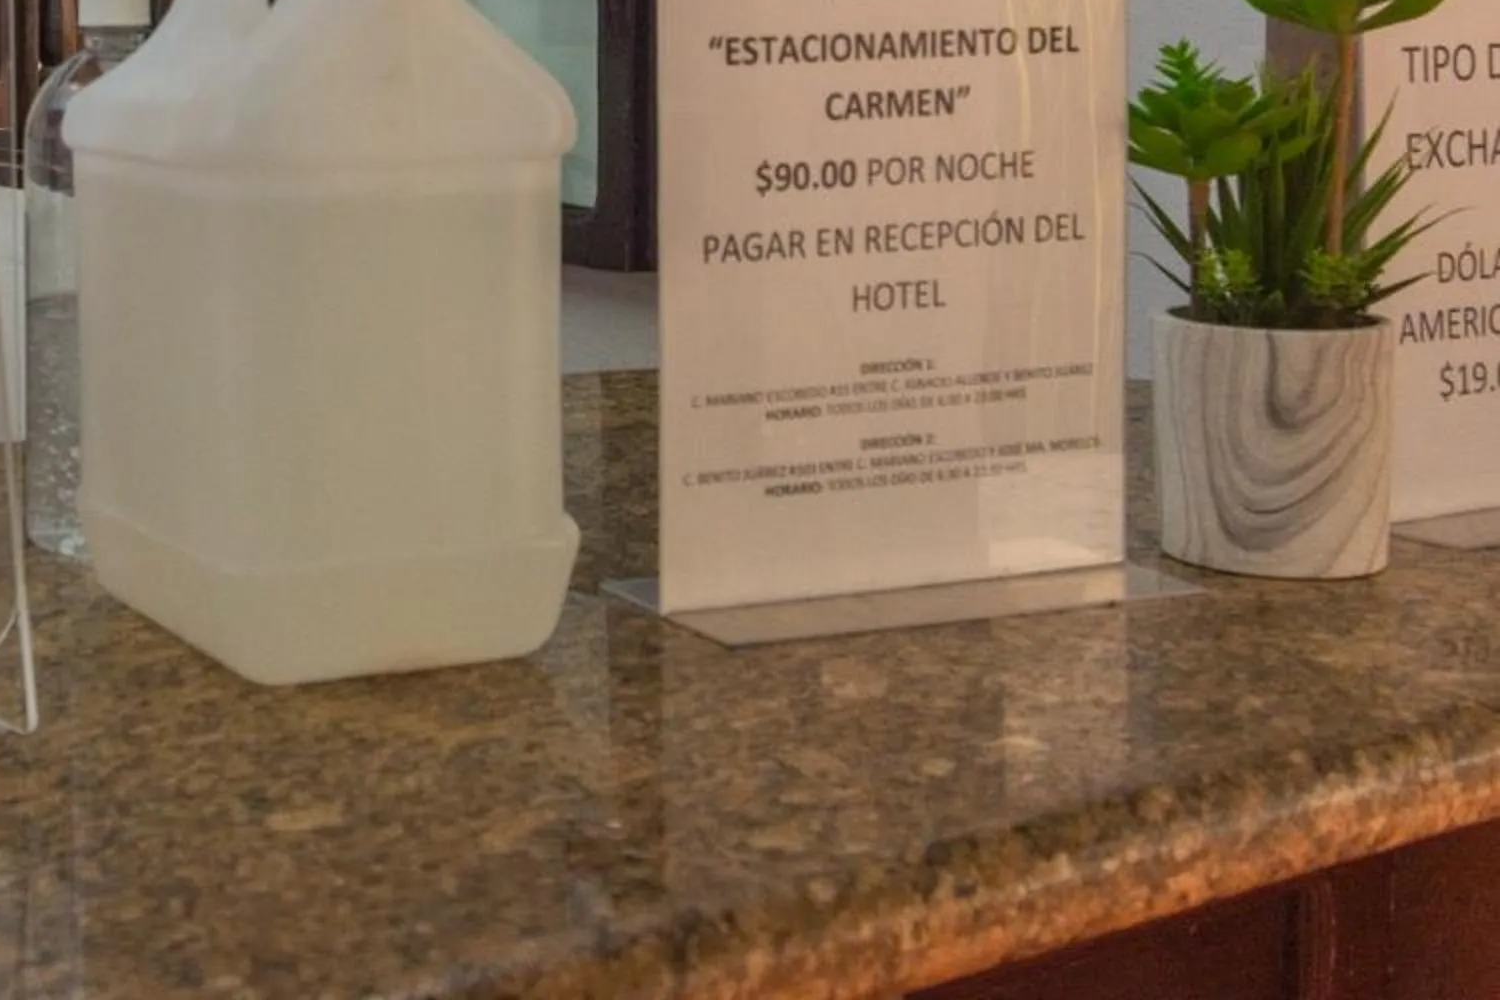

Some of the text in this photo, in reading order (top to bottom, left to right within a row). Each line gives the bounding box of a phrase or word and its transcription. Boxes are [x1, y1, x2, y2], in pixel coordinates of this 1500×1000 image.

[1027, 25, 1080, 55] DEL
[1400, 43, 1477, 83] TIPO
[755, 150, 1035, 197] $90.00 POR NOCHE
[702, 210, 1085, 264] PAGAR EN RECEPCIÓN DEL
[852, 280, 946, 312] HOTEL
[1399, 303, 1500, 345] AMERIC
[1440, 360, 1500, 402] $19.
